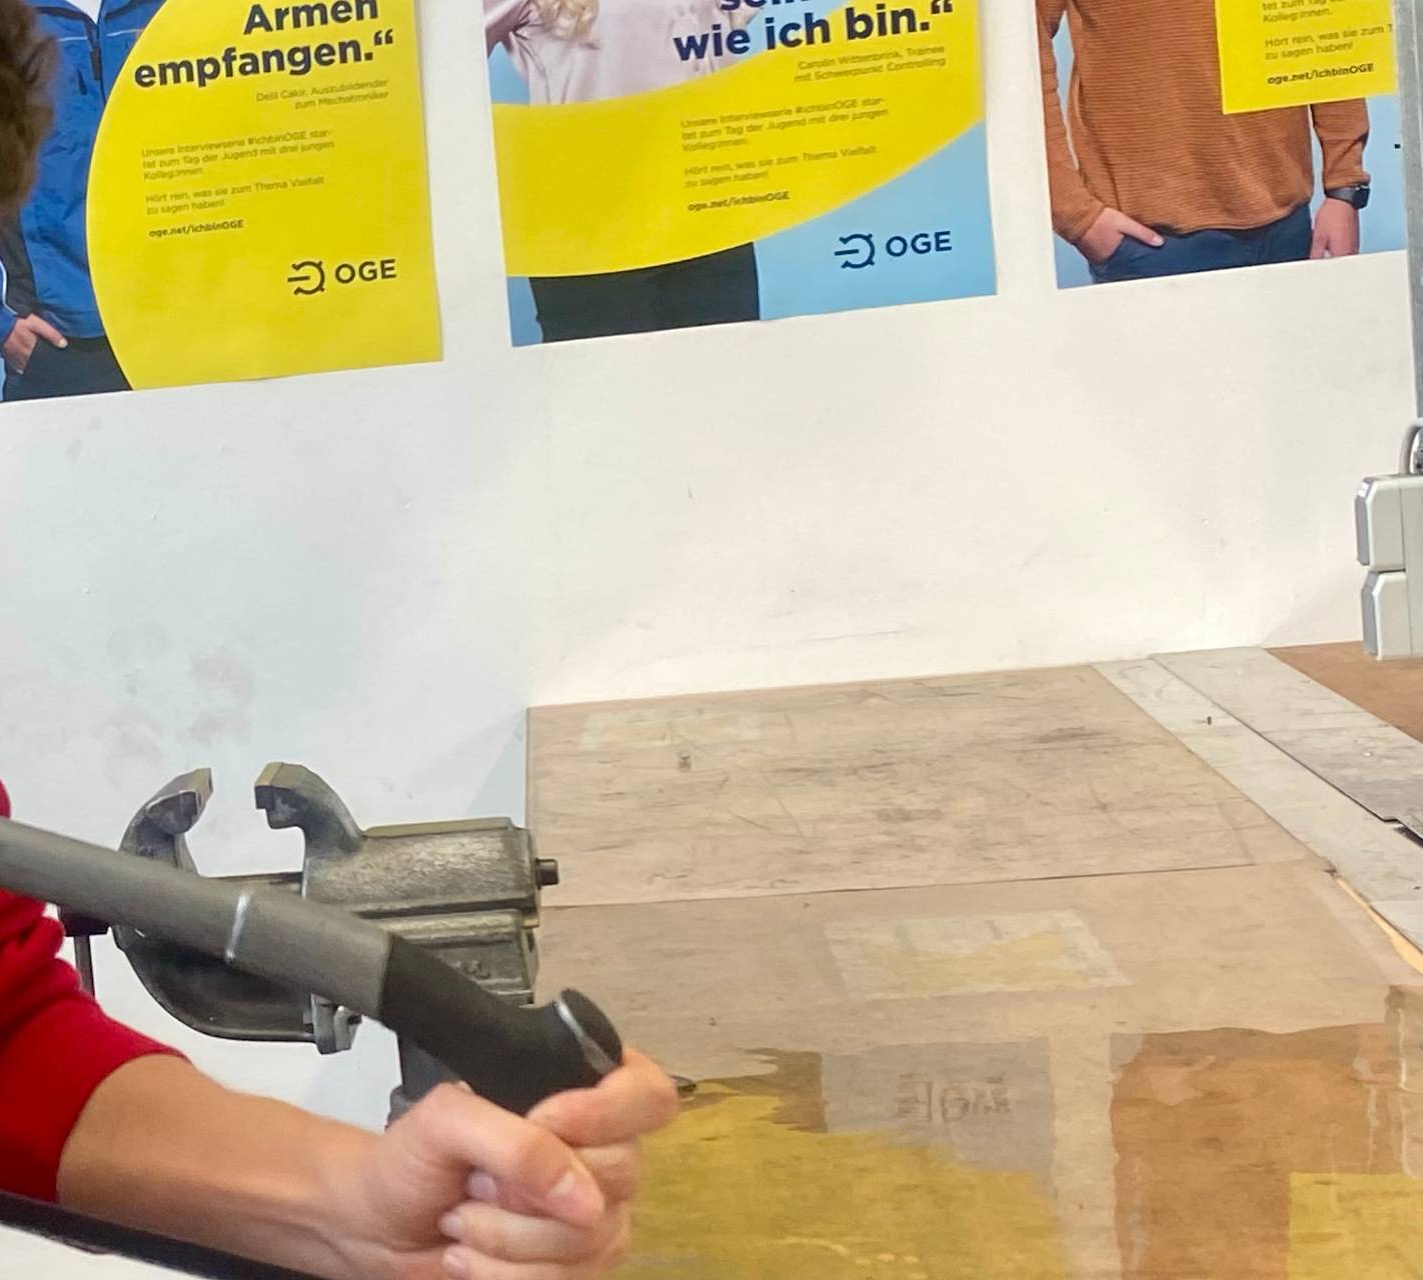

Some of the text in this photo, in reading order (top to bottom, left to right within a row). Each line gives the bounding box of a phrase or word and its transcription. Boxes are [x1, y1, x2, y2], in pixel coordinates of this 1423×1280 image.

[243, 0, 377, 34] Armen
[673, 24, 751, 61] wie
[765, 12, 830, 50] ich
[1265, 37, 1289, 48] Hört
[1319, 31, 1339, 40] was
[1343, 29, 1358, 38] sie
[1361, 25, 1384, 36] zum
[905, 46, 945, 57] Trainee
[1265, 41, 1353, 60] zu sagen haben!
[794, 57, 946, 83] mit Schwerpunkt Controlling
[1267, 63, 1374, 85] oge.net/ichbinOGE
[310, 79, 388, 95] Auszubildender
[295, 92, 389, 110] zum Mechatroniker
[680, 117, 718, 128] Unsere
[720, 107, 793, 124] Interviewserie
[700, 129, 722, 139] zum
[725, 125, 744, 137] Tag
[746, 122, 763, 133] der
[767, 118, 806, 131] Jugend
[809, 115, 826, 125] mit
[829, 112, 849, 123] drei
[851, 108, 889, 121] jungen
[141, 147, 175, 157] Unsere
[177, 138, 245, 155] Interviewserie
[248, 130, 307, 146] #ichbinOGE
[143, 141, 335, 169] tet zum Tag der Jugend mit drei jungen
[685, 164, 708, 177] Hört
[736, 160, 755, 170] was
[759, 158, 773, 168] sie
[777, 155, 798, 166] zum
[802, 152, 837, 163] Thema
[840, 146, 876, 158] Vielfalt
[146, 191, 167, 203] Hört
[193, 188, 212, 198] was
[215, 186, 228, 197] sie
[231, 185, 252, 195] zum
[254, 181, 288, 193] Thema
[291, 175, 325, 188] Vielfalt
[685, 179, 698, 189] zu
[701, 175, 731, 187] sagen
[147, 198, 225, 215] zu sagen haben!
[687, 190, 790, 212] oge.net/ichbinOGE
[149, 219, 244, 238] oge.net/ichbinOGE
[885, 231, 952, 257] OGE
[335, 259, 397, 284] OGE
